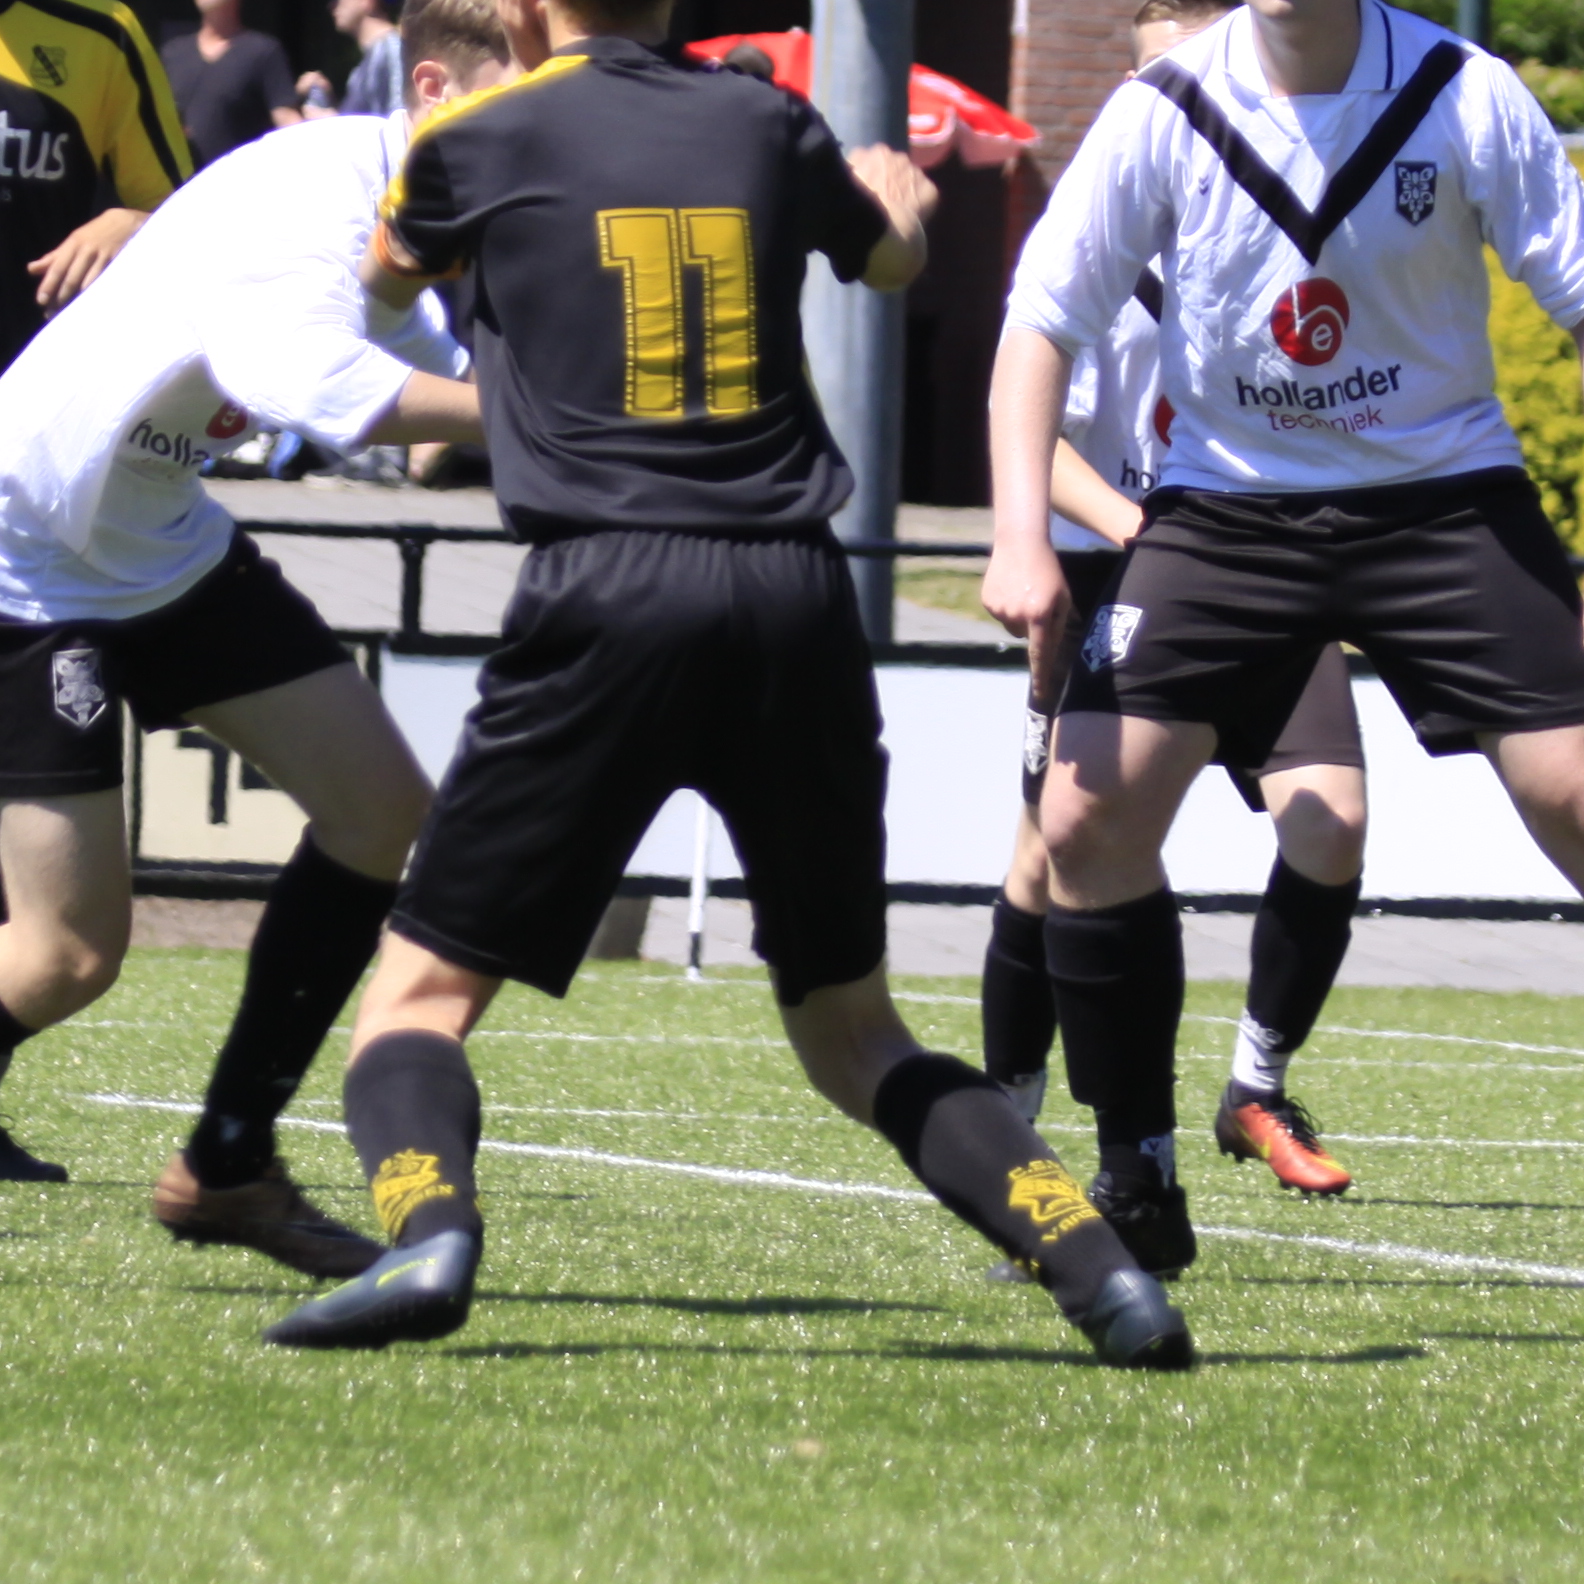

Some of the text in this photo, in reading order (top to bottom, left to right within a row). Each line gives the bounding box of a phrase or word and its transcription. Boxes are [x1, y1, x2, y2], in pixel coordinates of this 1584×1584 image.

[597, 207, 760, 418] 11
[1235, 363, 1402, 411] hollander
[1266, 403, 1384, 434] techniek
